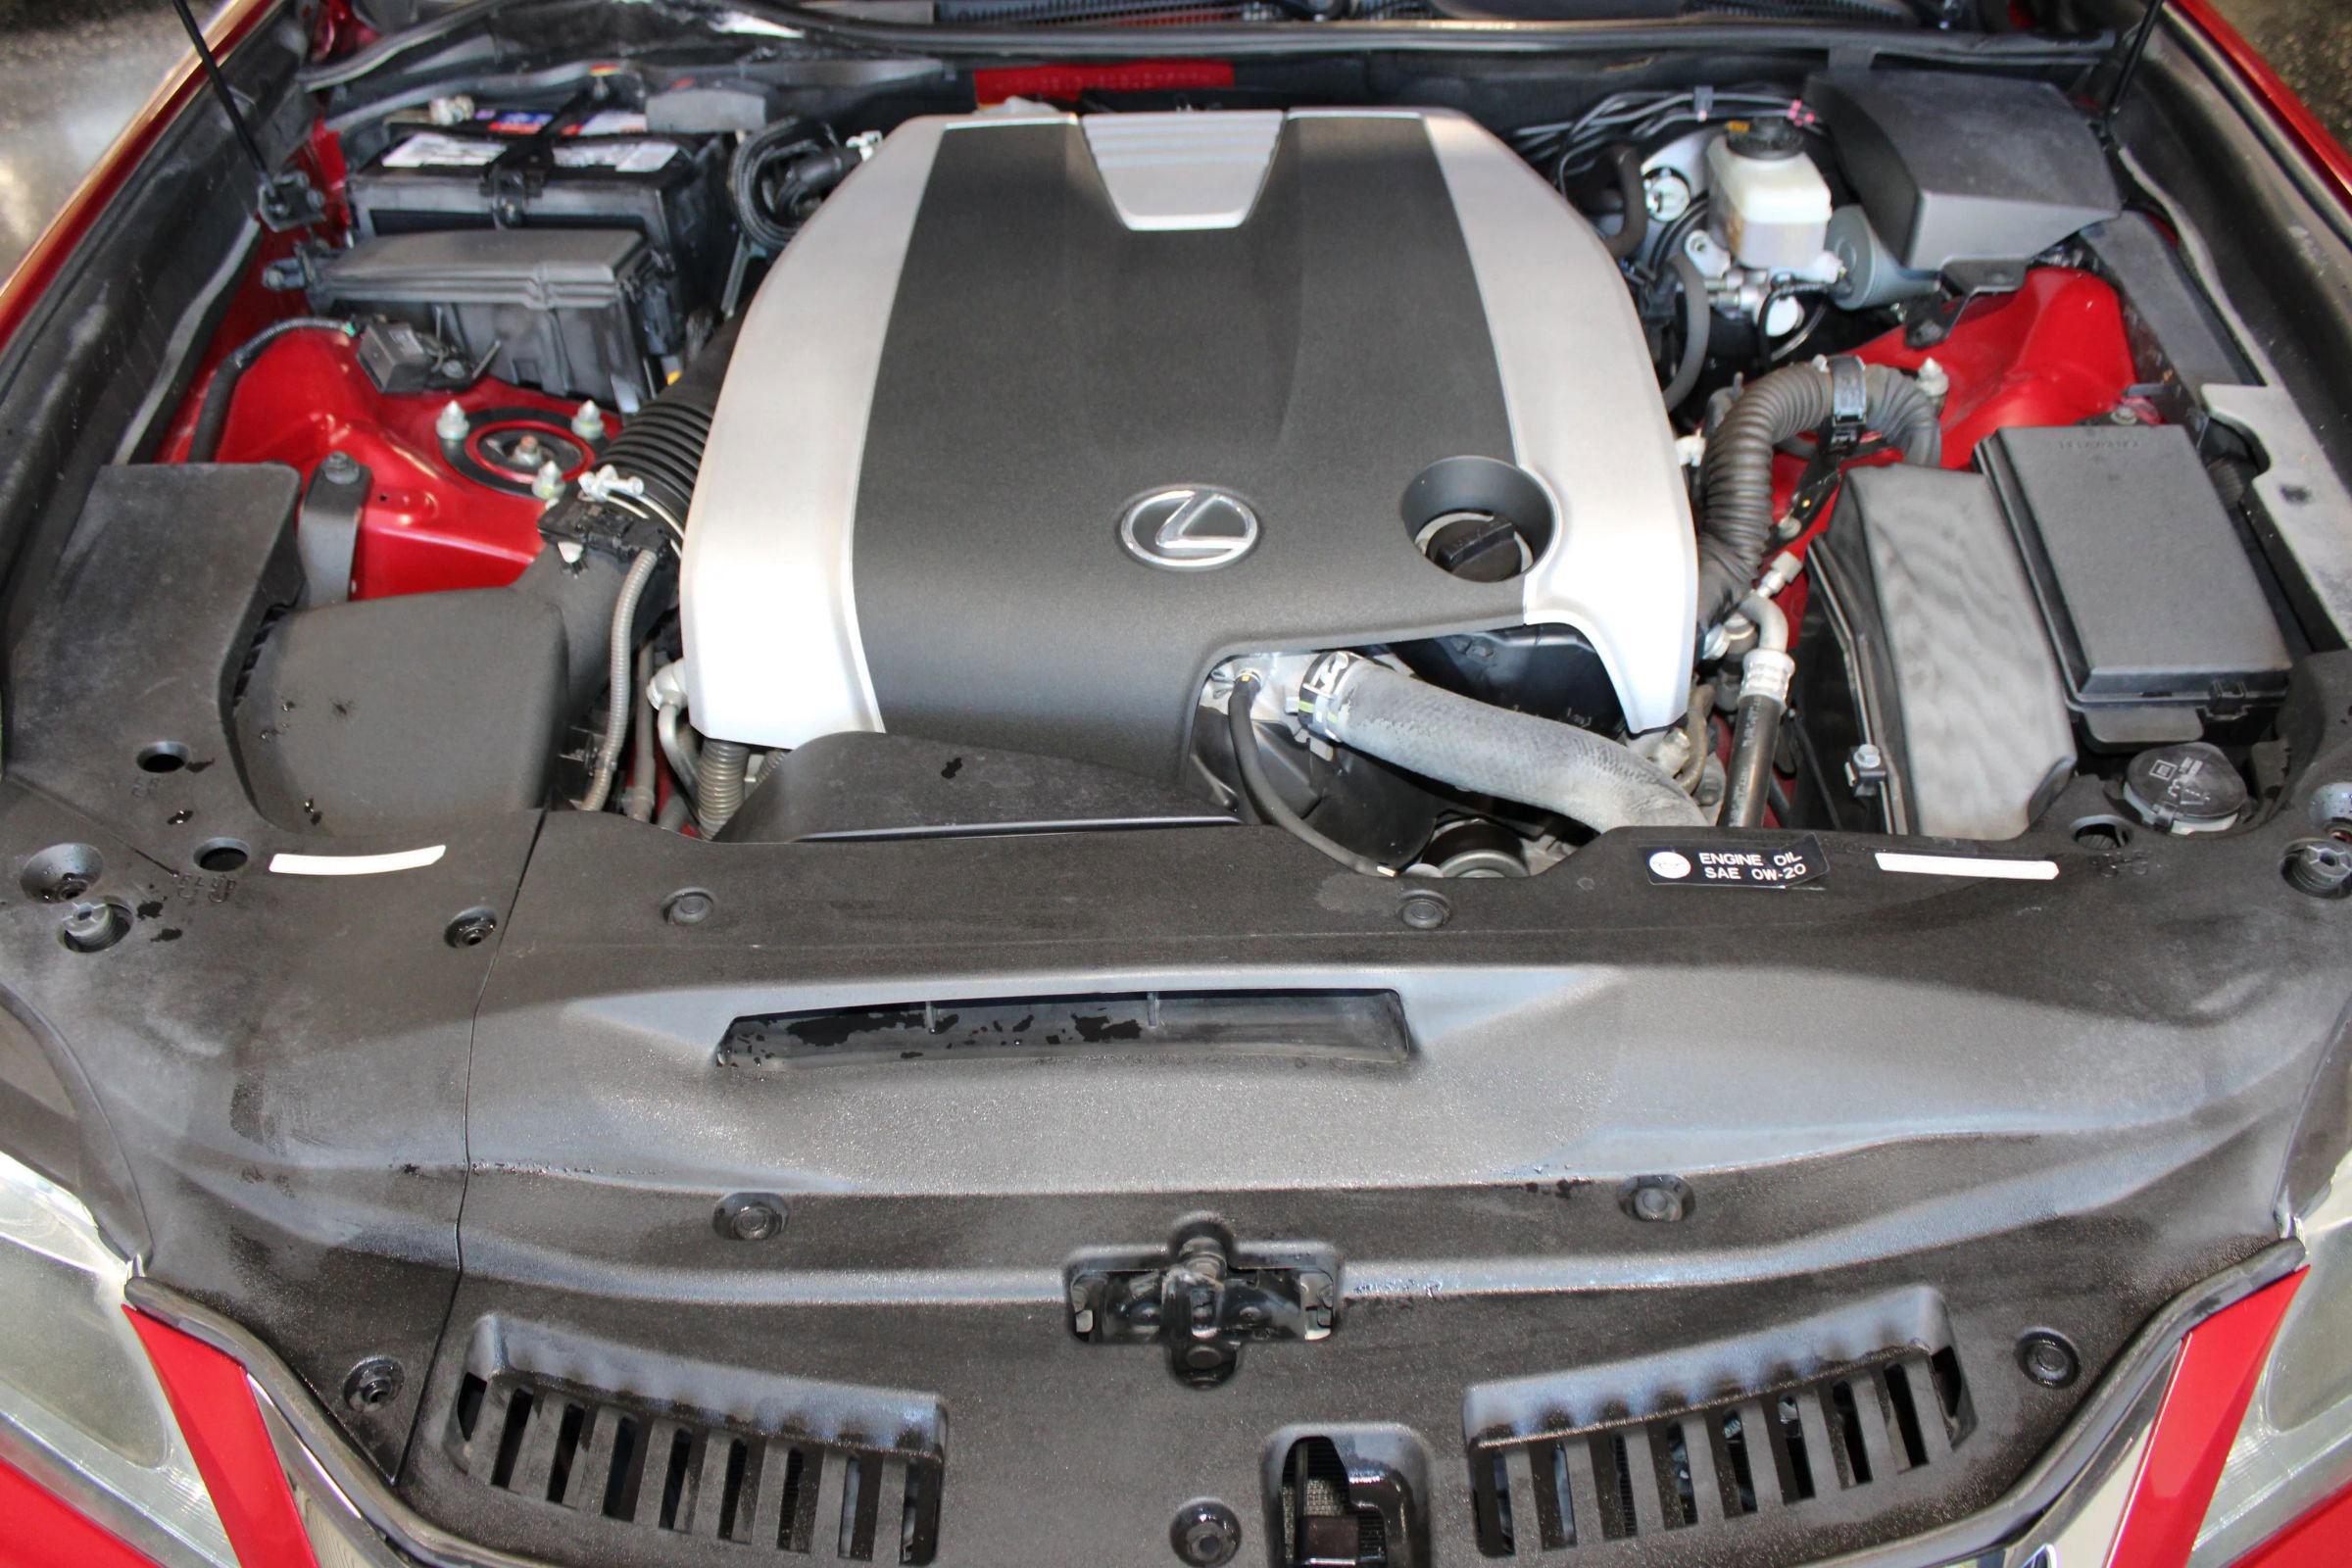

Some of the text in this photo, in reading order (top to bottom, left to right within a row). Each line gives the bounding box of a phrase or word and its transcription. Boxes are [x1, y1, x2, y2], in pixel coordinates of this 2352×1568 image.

[1698, 852, 1803, 866] ENGINE OIL
[1705, 863, 1807, 881] SAE 0W-20
